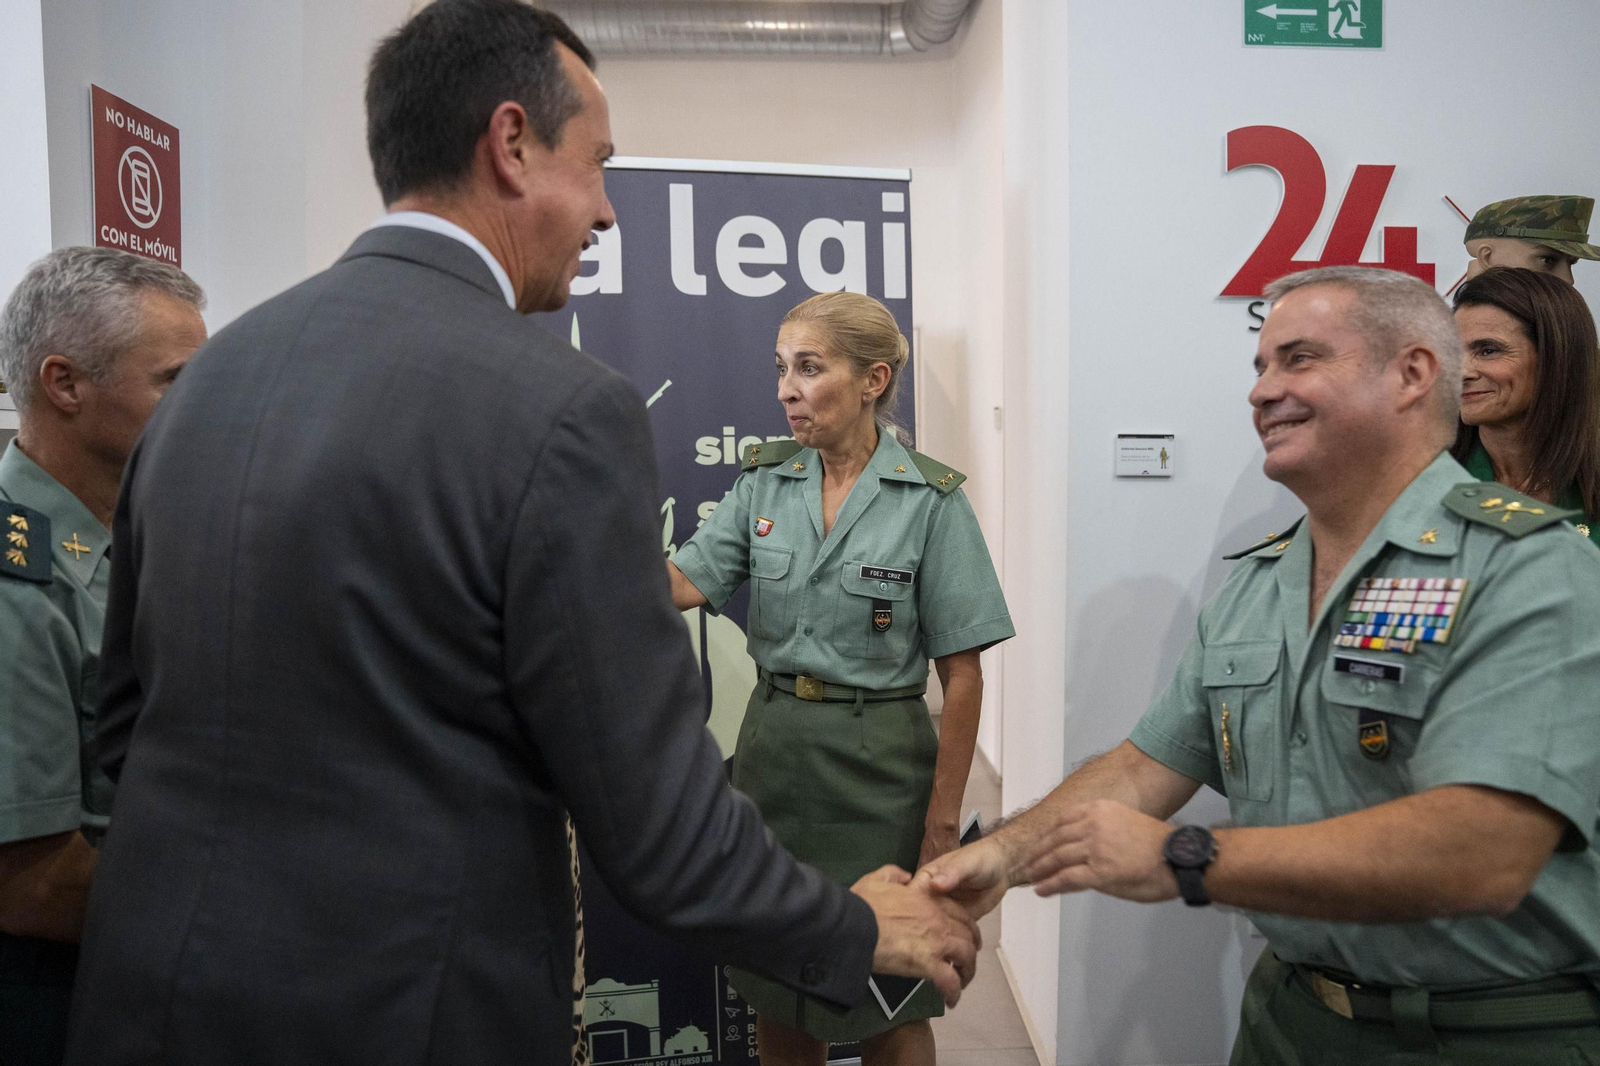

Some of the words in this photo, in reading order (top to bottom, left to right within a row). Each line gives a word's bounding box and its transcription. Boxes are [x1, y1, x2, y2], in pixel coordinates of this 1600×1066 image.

[105, 106, 125, 128] NO
[127, 117, 170, 151] HABLAR
[1219, 125, 1436, 297] 24
[101, 225, 128, 247] CON
[130, 233, 143, 252] EL
[145, 237, 177, 263] MÓVIL
[569, 219, 623, 296] a
[670, 1056, 700, 1066] ALFONSO
